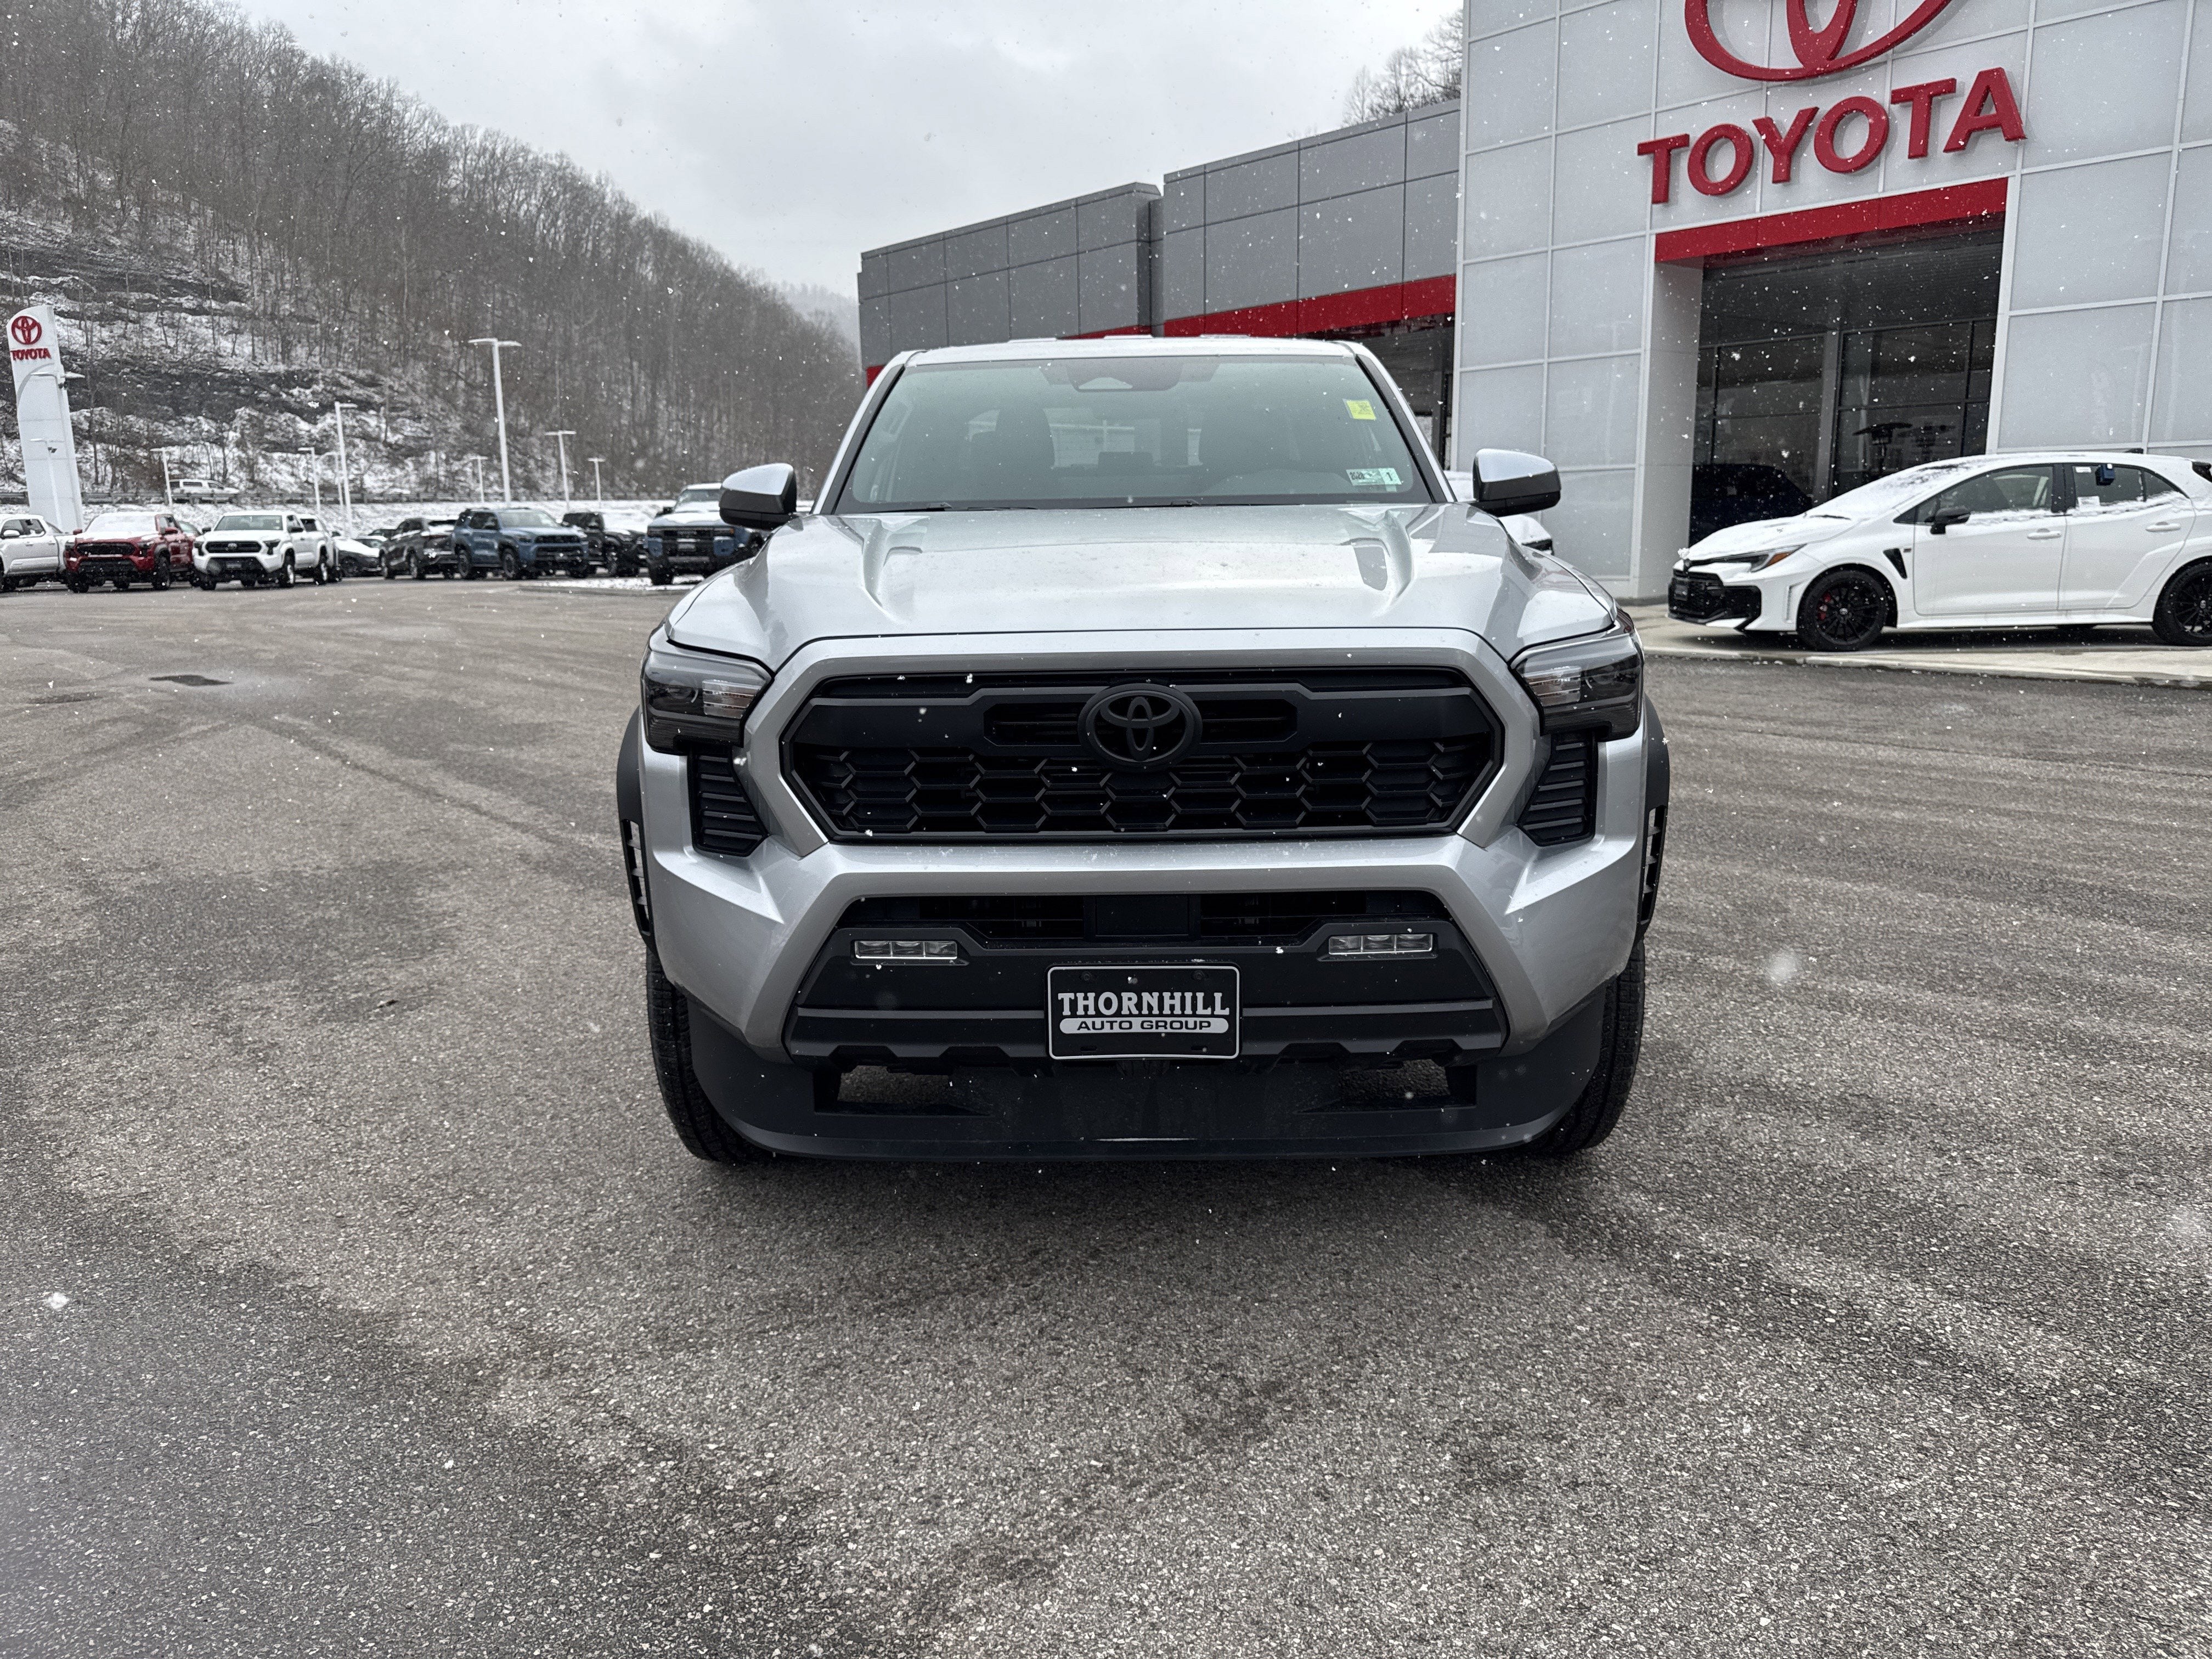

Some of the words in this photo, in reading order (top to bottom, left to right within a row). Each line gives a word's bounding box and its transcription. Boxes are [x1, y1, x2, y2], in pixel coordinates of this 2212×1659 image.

[1637, 67, 2027, 205] TOYOTA
[10, 348, 52, 360] TOYOTA
[1058, 991, 1229, 1015] THORNHILL
[1077, 1020, 1133, 1031] AUTO
[1140, 1020, 1211, 1030] GROUP
